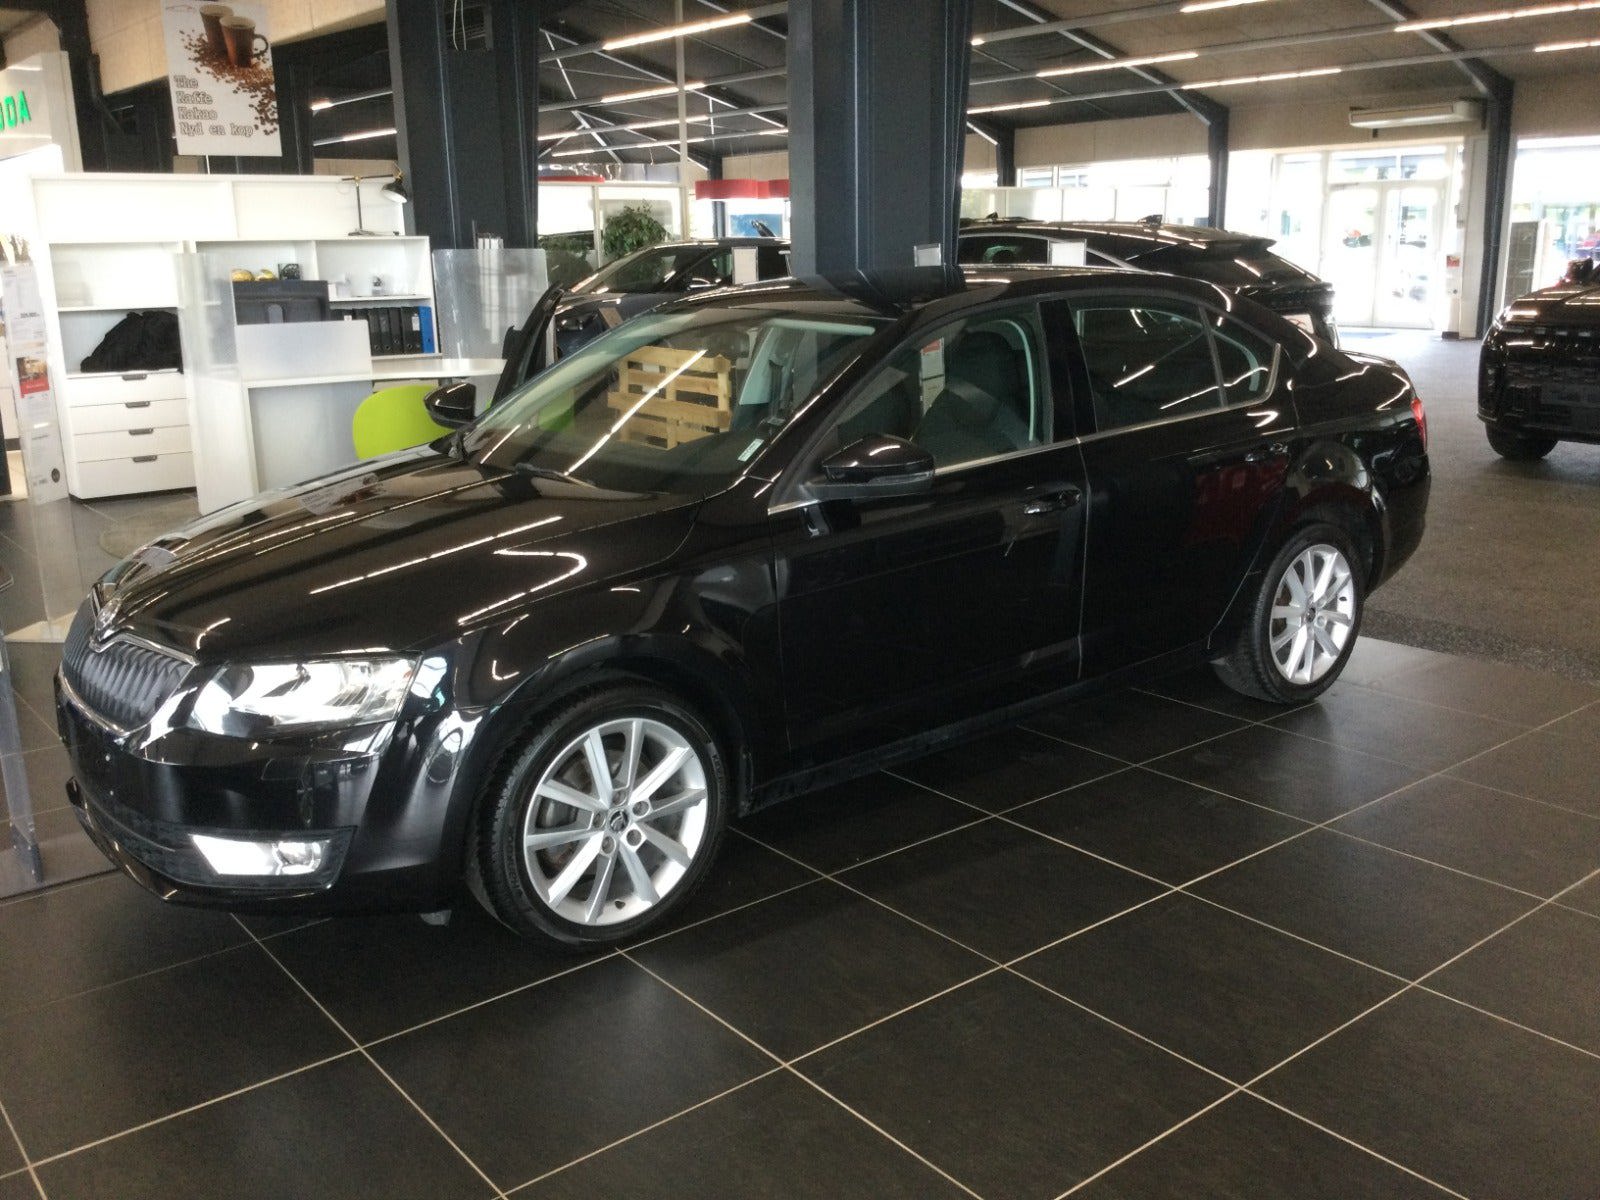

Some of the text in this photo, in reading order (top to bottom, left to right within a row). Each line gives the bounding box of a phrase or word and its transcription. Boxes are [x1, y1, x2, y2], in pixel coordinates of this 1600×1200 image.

[174, 75, 198, 89] The
[176, 91, 213, 105] Kaffe
[178, 107, 218, 120] Kakao
[180, 122, 254, 137] Nyd en kop
